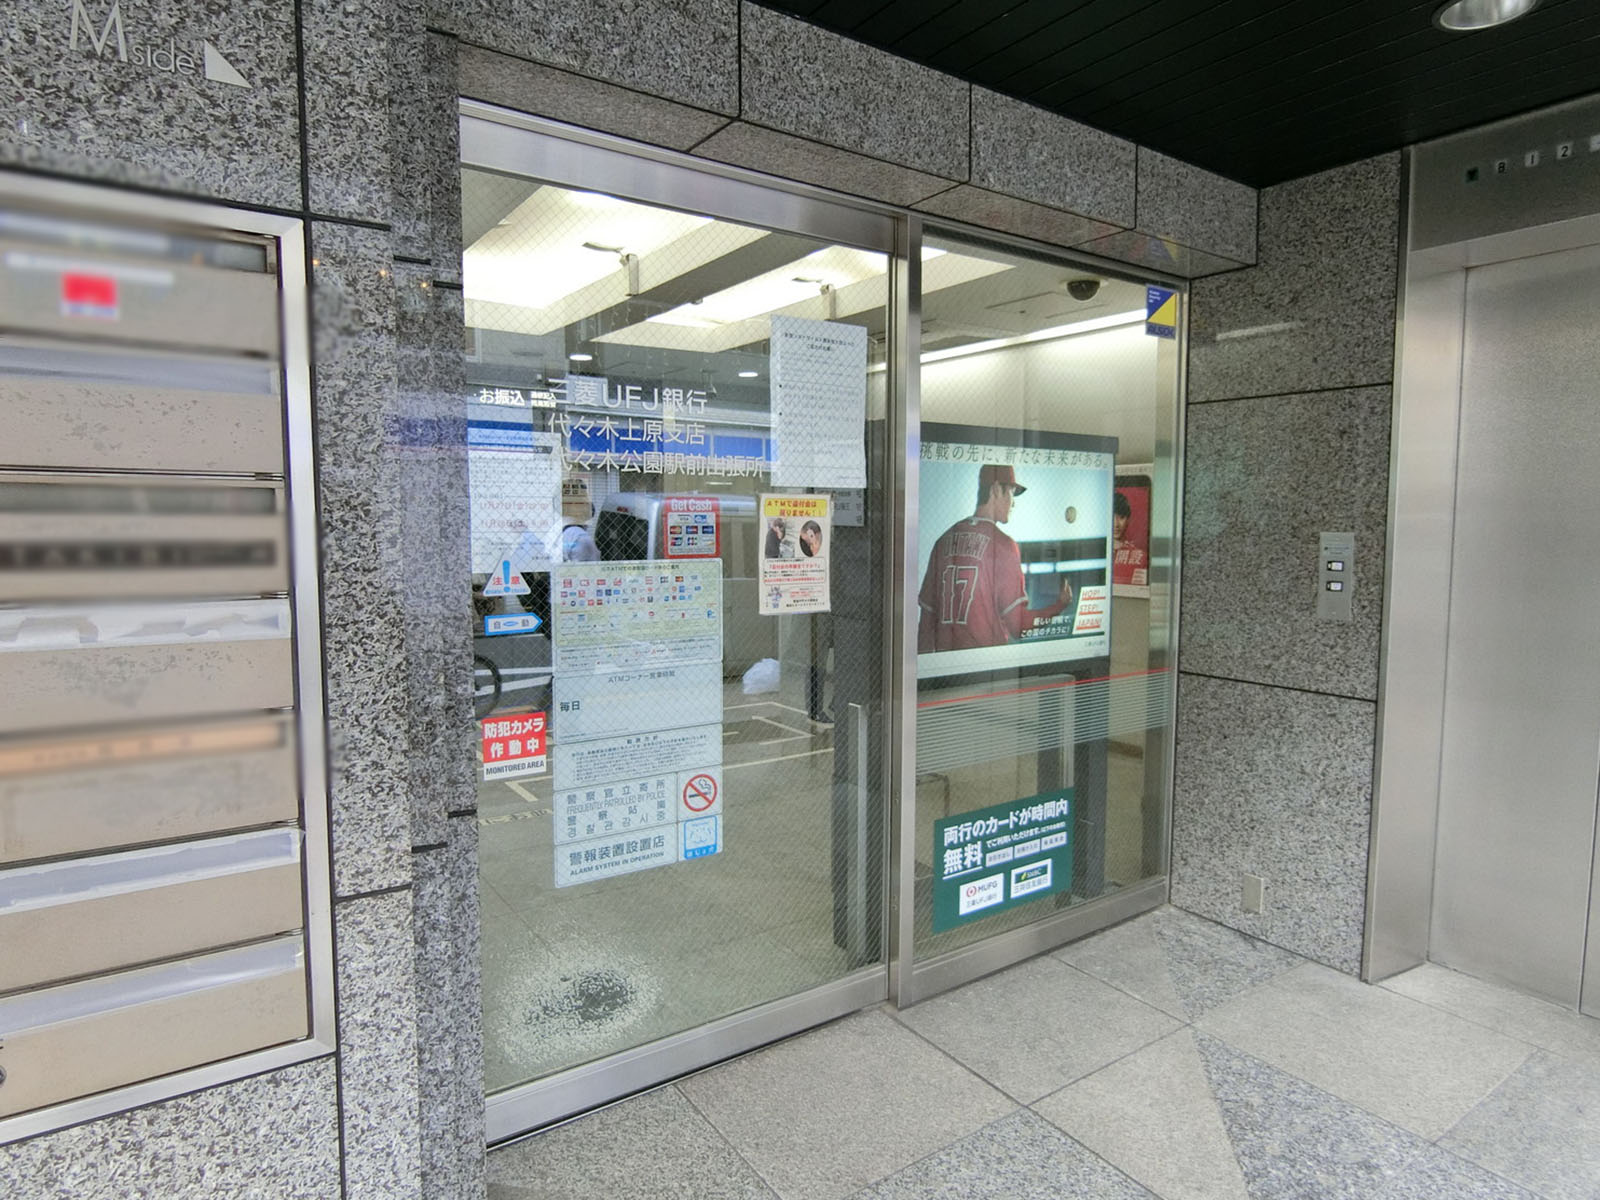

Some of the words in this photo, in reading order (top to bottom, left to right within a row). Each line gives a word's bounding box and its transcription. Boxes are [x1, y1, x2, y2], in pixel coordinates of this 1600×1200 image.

[479, 388, 525, 407] お振込
[548, 378, 707, 414] 三菱UFJ銀行
[547, 412, 706, 446] 代々木上原支店
[549, 447, 766, 478] 代々木公園駅前出張所
[671, 499, 688, 511] Get
[689, 498, 712, 511] Cash
[941, 564, 979, 625] 17
[559, 701, 581, 712] 毎日
[484, 717, 544, 739] 防犯カメラ
[490, 737, 540, 759] 作動中
[486, 763, 527, 775] MONITORED
[526, 760, 544, 769] AREA
[943, 798, 1069, 847] 両行のカードが時間内
[569, 835, 665, 866] 警報装置設置店
[570, 867, 594, 876] ALARM
[595, 861, 620, 871] SYSTEM
[630, 852, 664, 864] OPERATION
[943, 841, 982, 875] 無料
